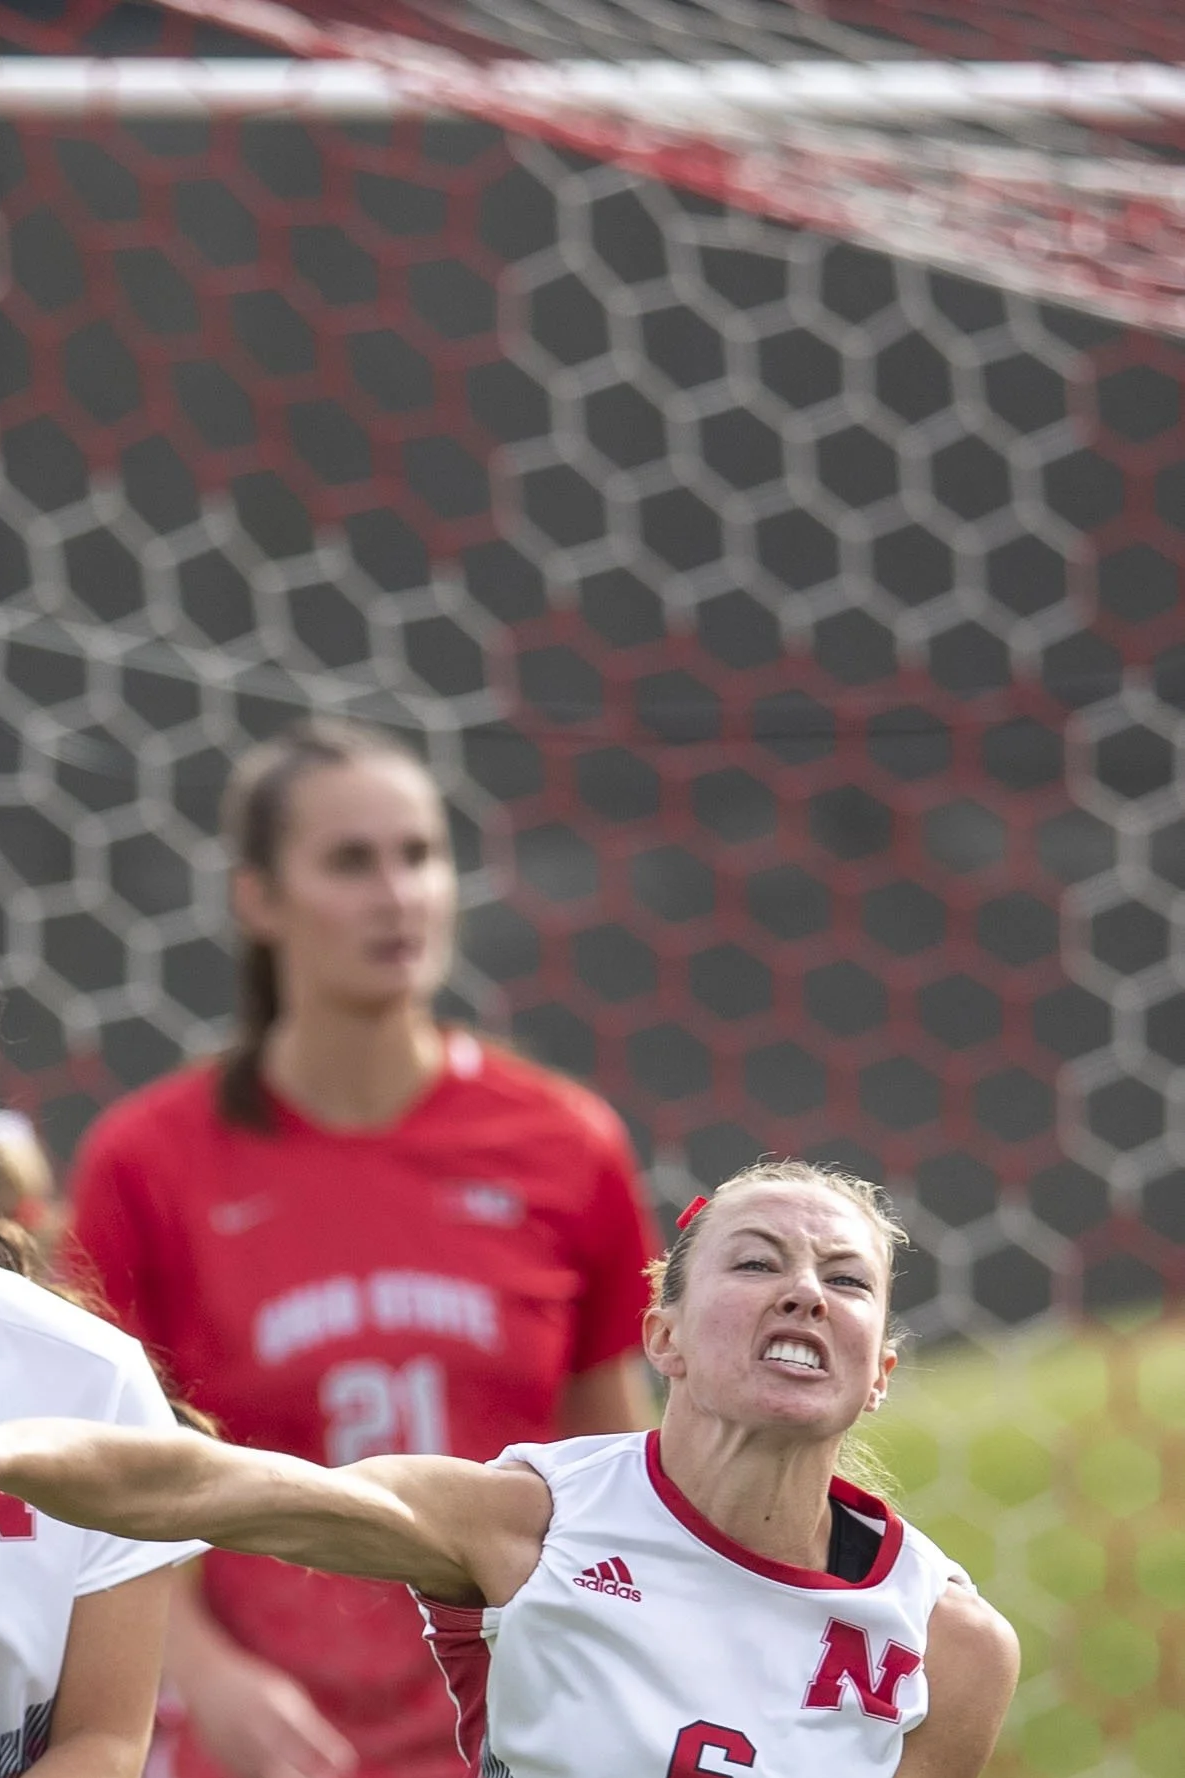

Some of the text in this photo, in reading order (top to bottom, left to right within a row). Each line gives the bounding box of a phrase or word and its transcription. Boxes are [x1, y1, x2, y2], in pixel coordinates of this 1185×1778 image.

[320, 1358, 451, 1467] 21
[572, 1577, 642, 1603] adidas
[800, 1616, 924, 1725] N
